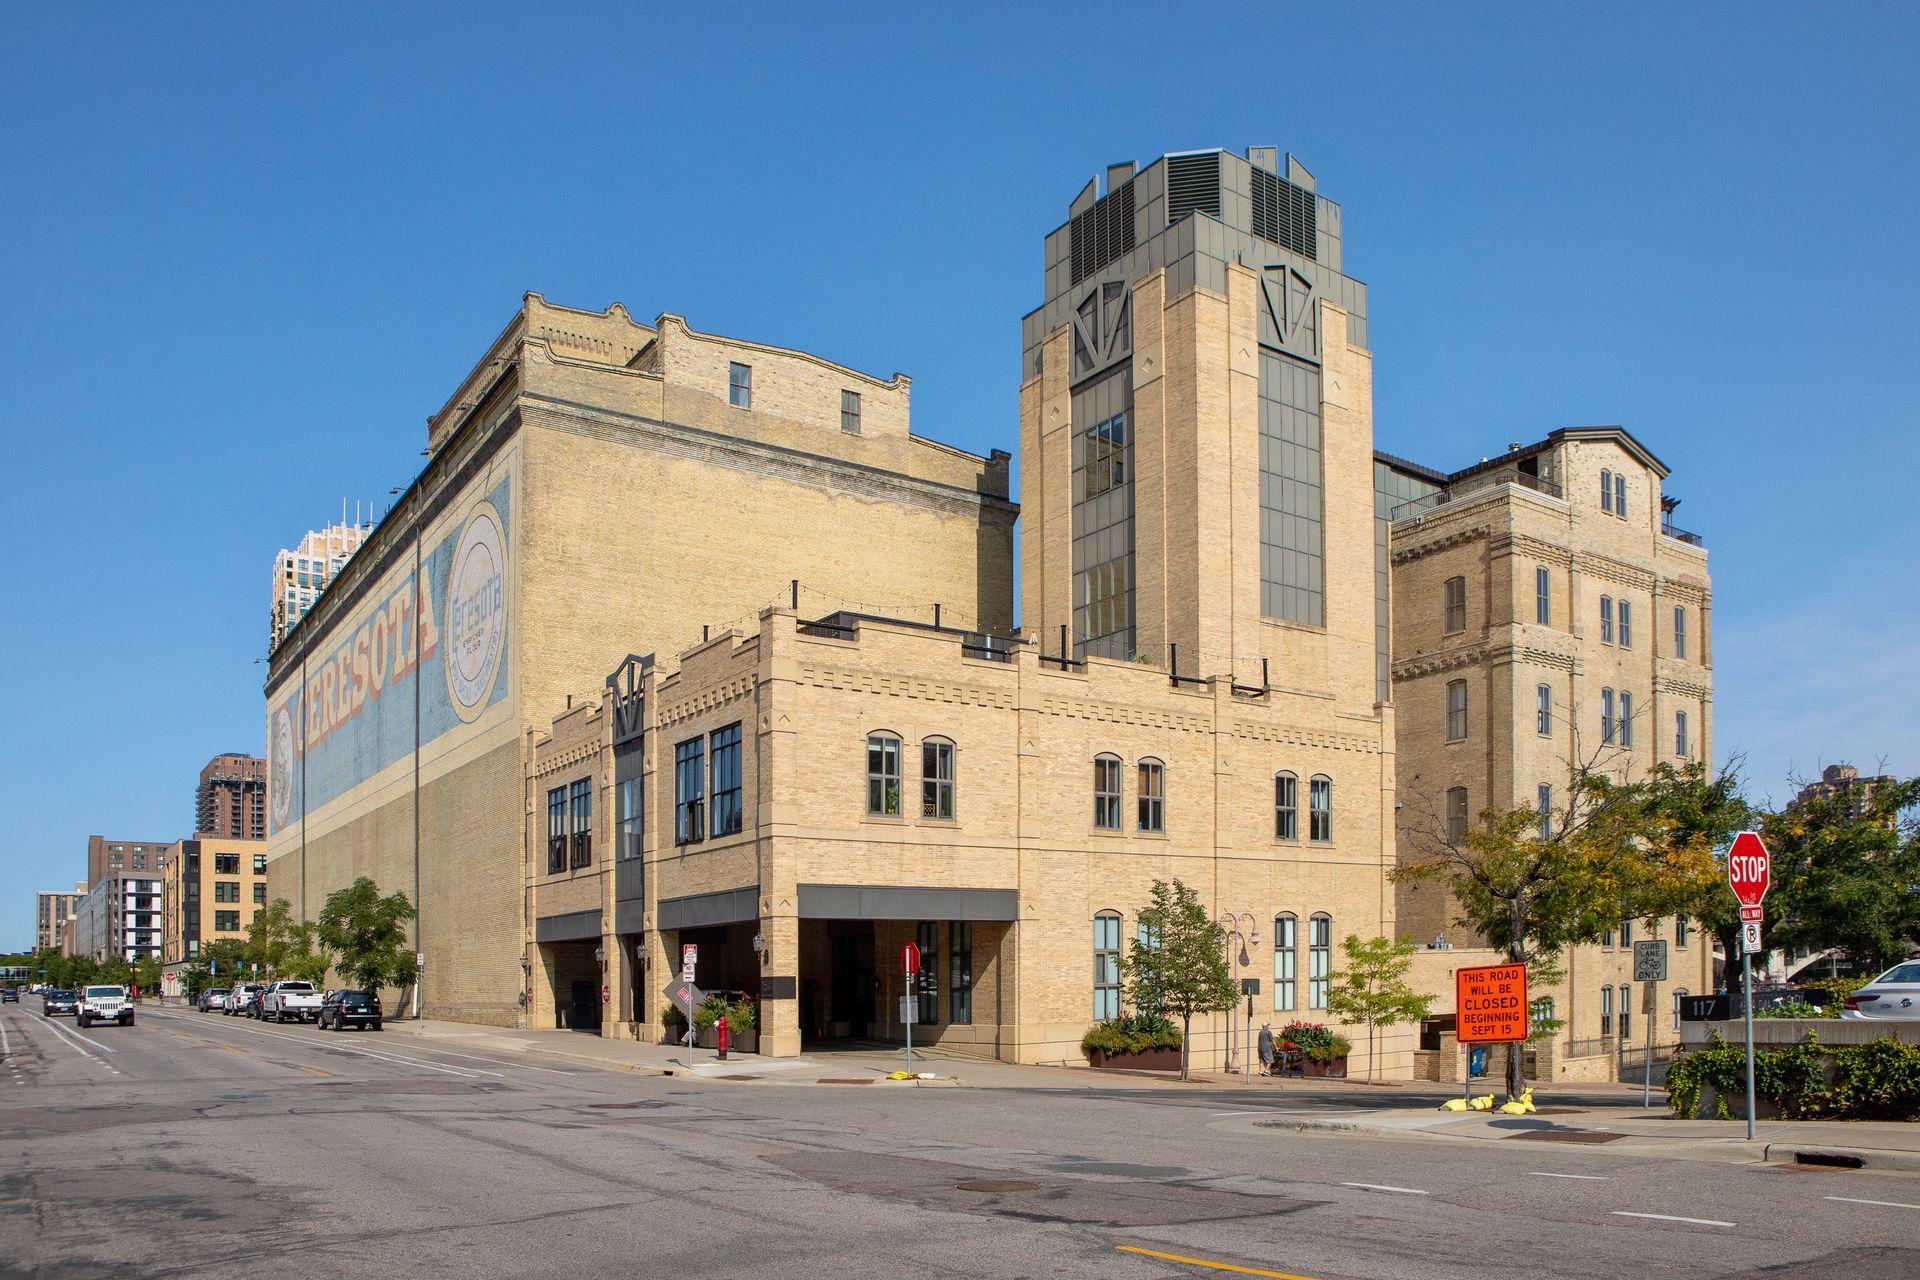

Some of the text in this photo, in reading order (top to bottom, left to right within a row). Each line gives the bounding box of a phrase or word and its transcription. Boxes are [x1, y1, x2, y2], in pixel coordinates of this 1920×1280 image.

[295, 564, 439, 761] CERESOTA
[1731, 855, 1766, 883] STOP
[1742, 909, 1761, 919] ALL WAY
[1463, 970, 1519, 983] THIS ROAD
[1638, 971, 1661, 979] ONLY
[1471, 983, 1512, 996] WILL BE
[1464, 997, 1519, 1011] CLOSED
[1692, 1000, 1716, 1016] 117
[1464, 1012, 1519, 1024] BEGINNING
[1472, 1024, 1512, 1036] SEPT 15
